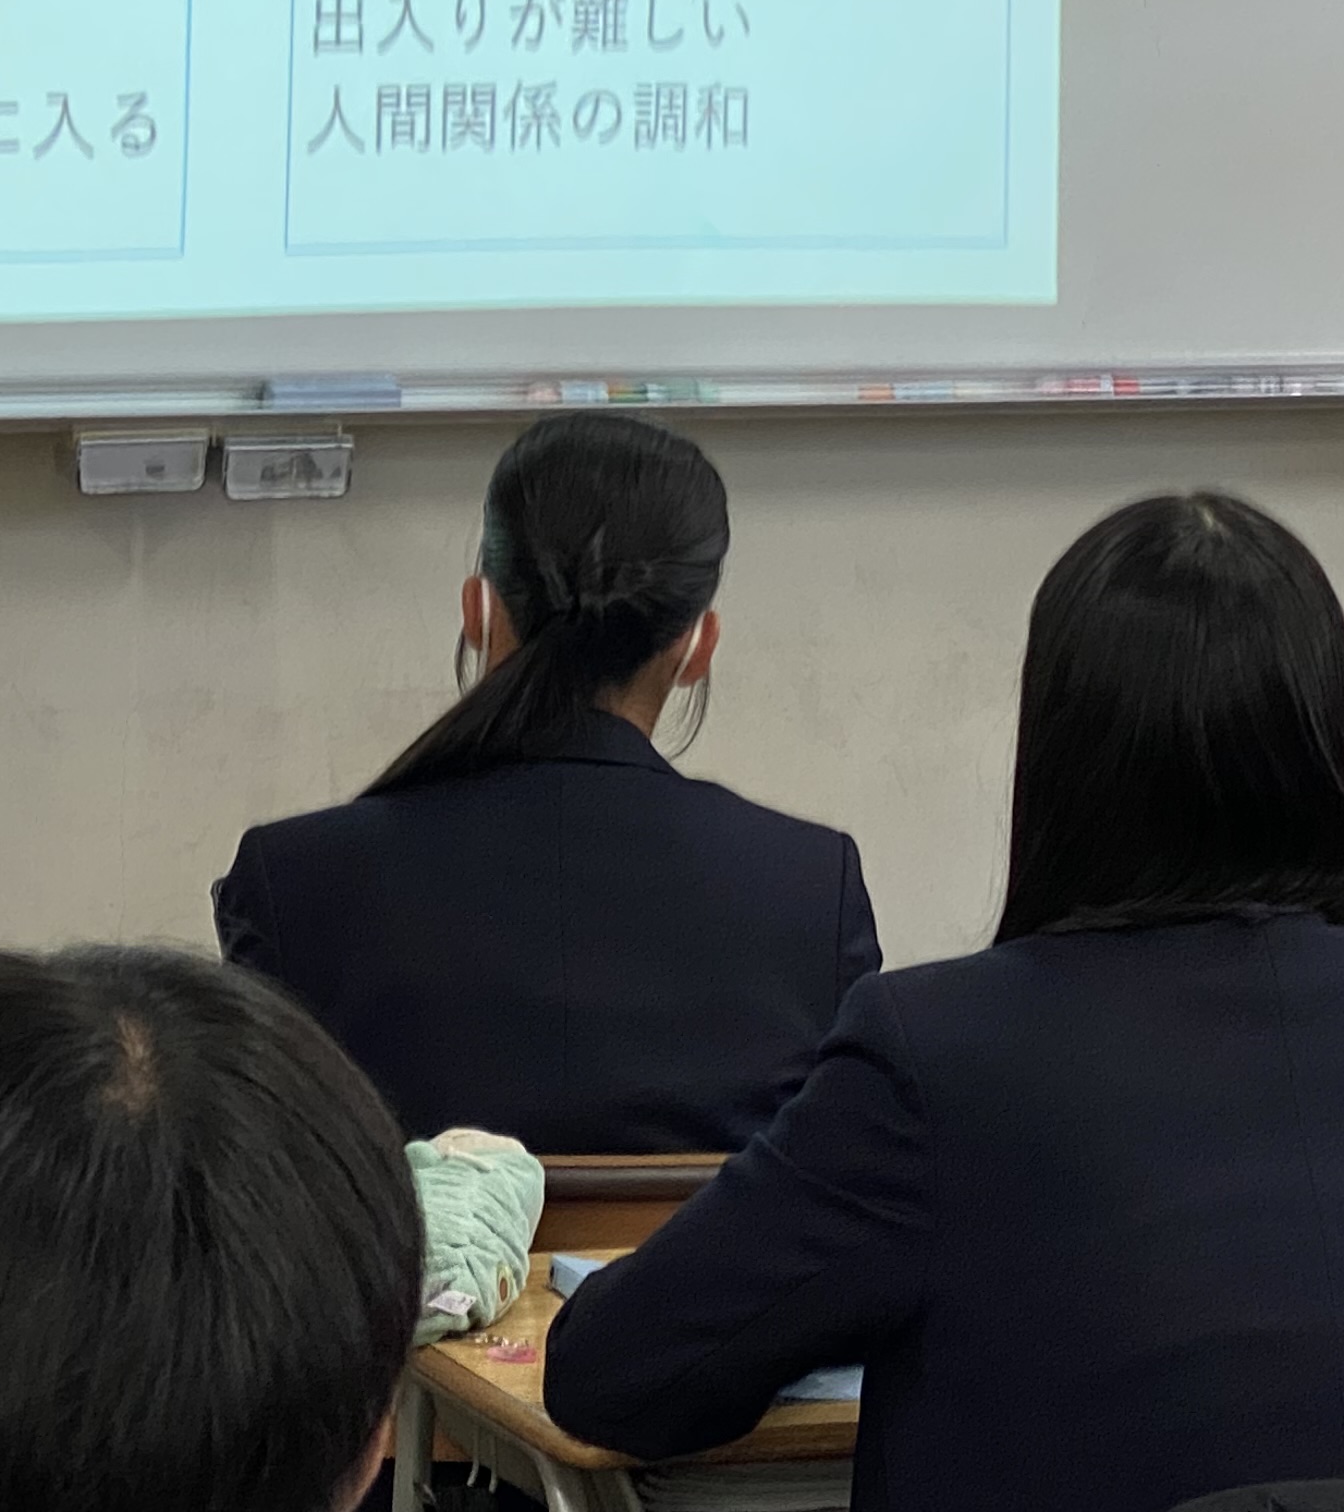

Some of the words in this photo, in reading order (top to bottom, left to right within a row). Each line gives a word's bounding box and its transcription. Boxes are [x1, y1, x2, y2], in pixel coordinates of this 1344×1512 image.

[306, 82, 751, 155] 人間関係の調和
